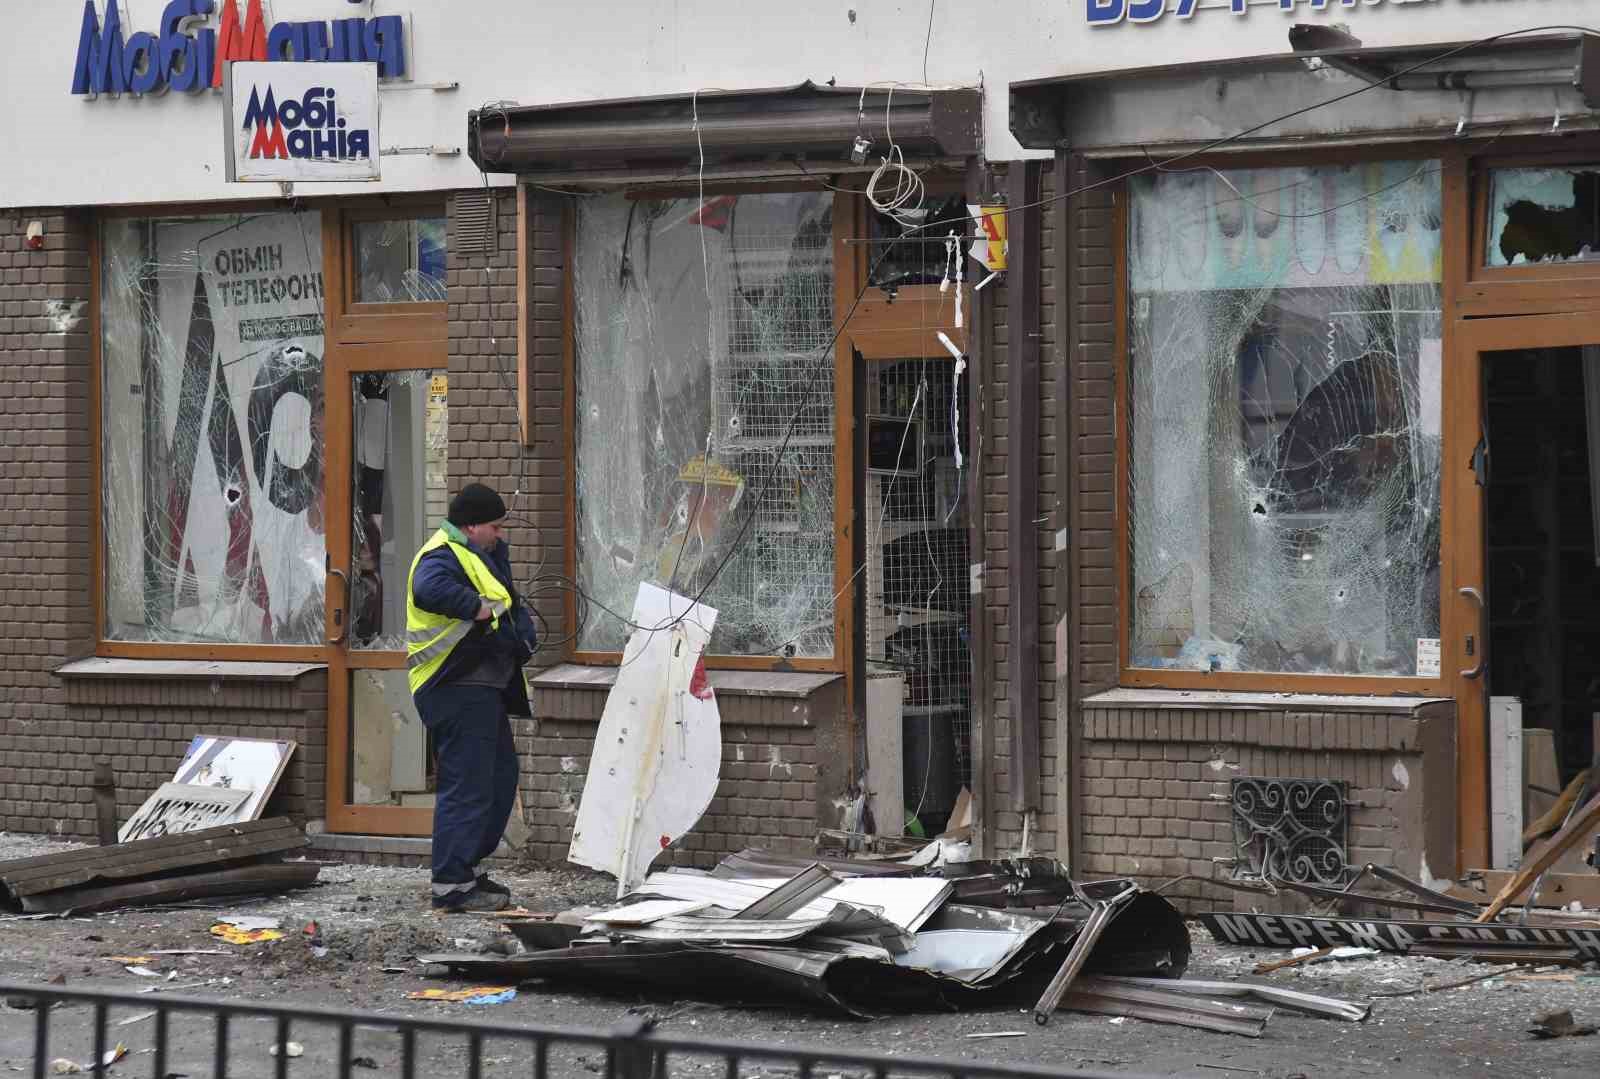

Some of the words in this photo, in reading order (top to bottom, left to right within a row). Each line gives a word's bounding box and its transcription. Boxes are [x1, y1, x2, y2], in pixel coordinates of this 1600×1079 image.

[249, 111, 370, 160] Манія
[215, 244, 282, 276] ОБМІН
[1213, 914, 1416, 951] МЕРЕЖА
